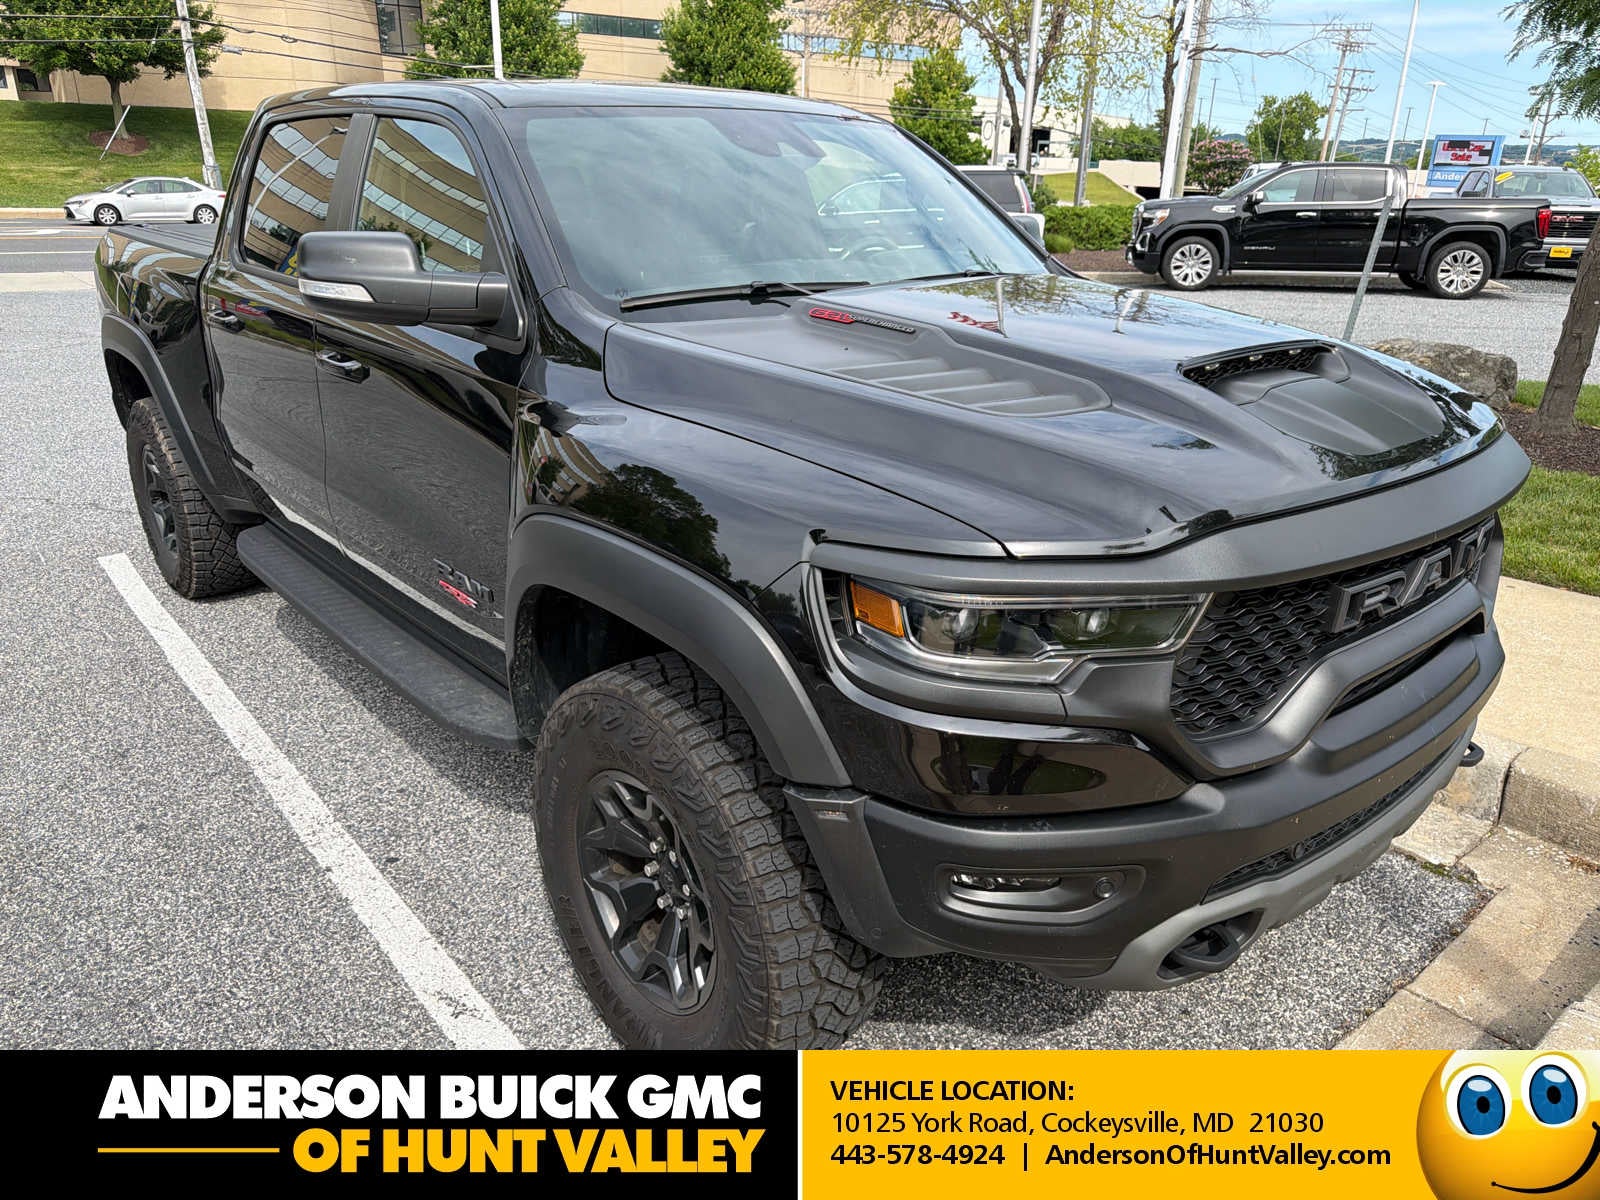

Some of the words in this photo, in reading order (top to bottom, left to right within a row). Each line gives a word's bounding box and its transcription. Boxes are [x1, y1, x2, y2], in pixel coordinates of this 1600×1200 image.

[1552, 215, 1585, 223] GMC
[433, 558, 494, 602] RAM
[1331, 514, 1496, 633] RAM
